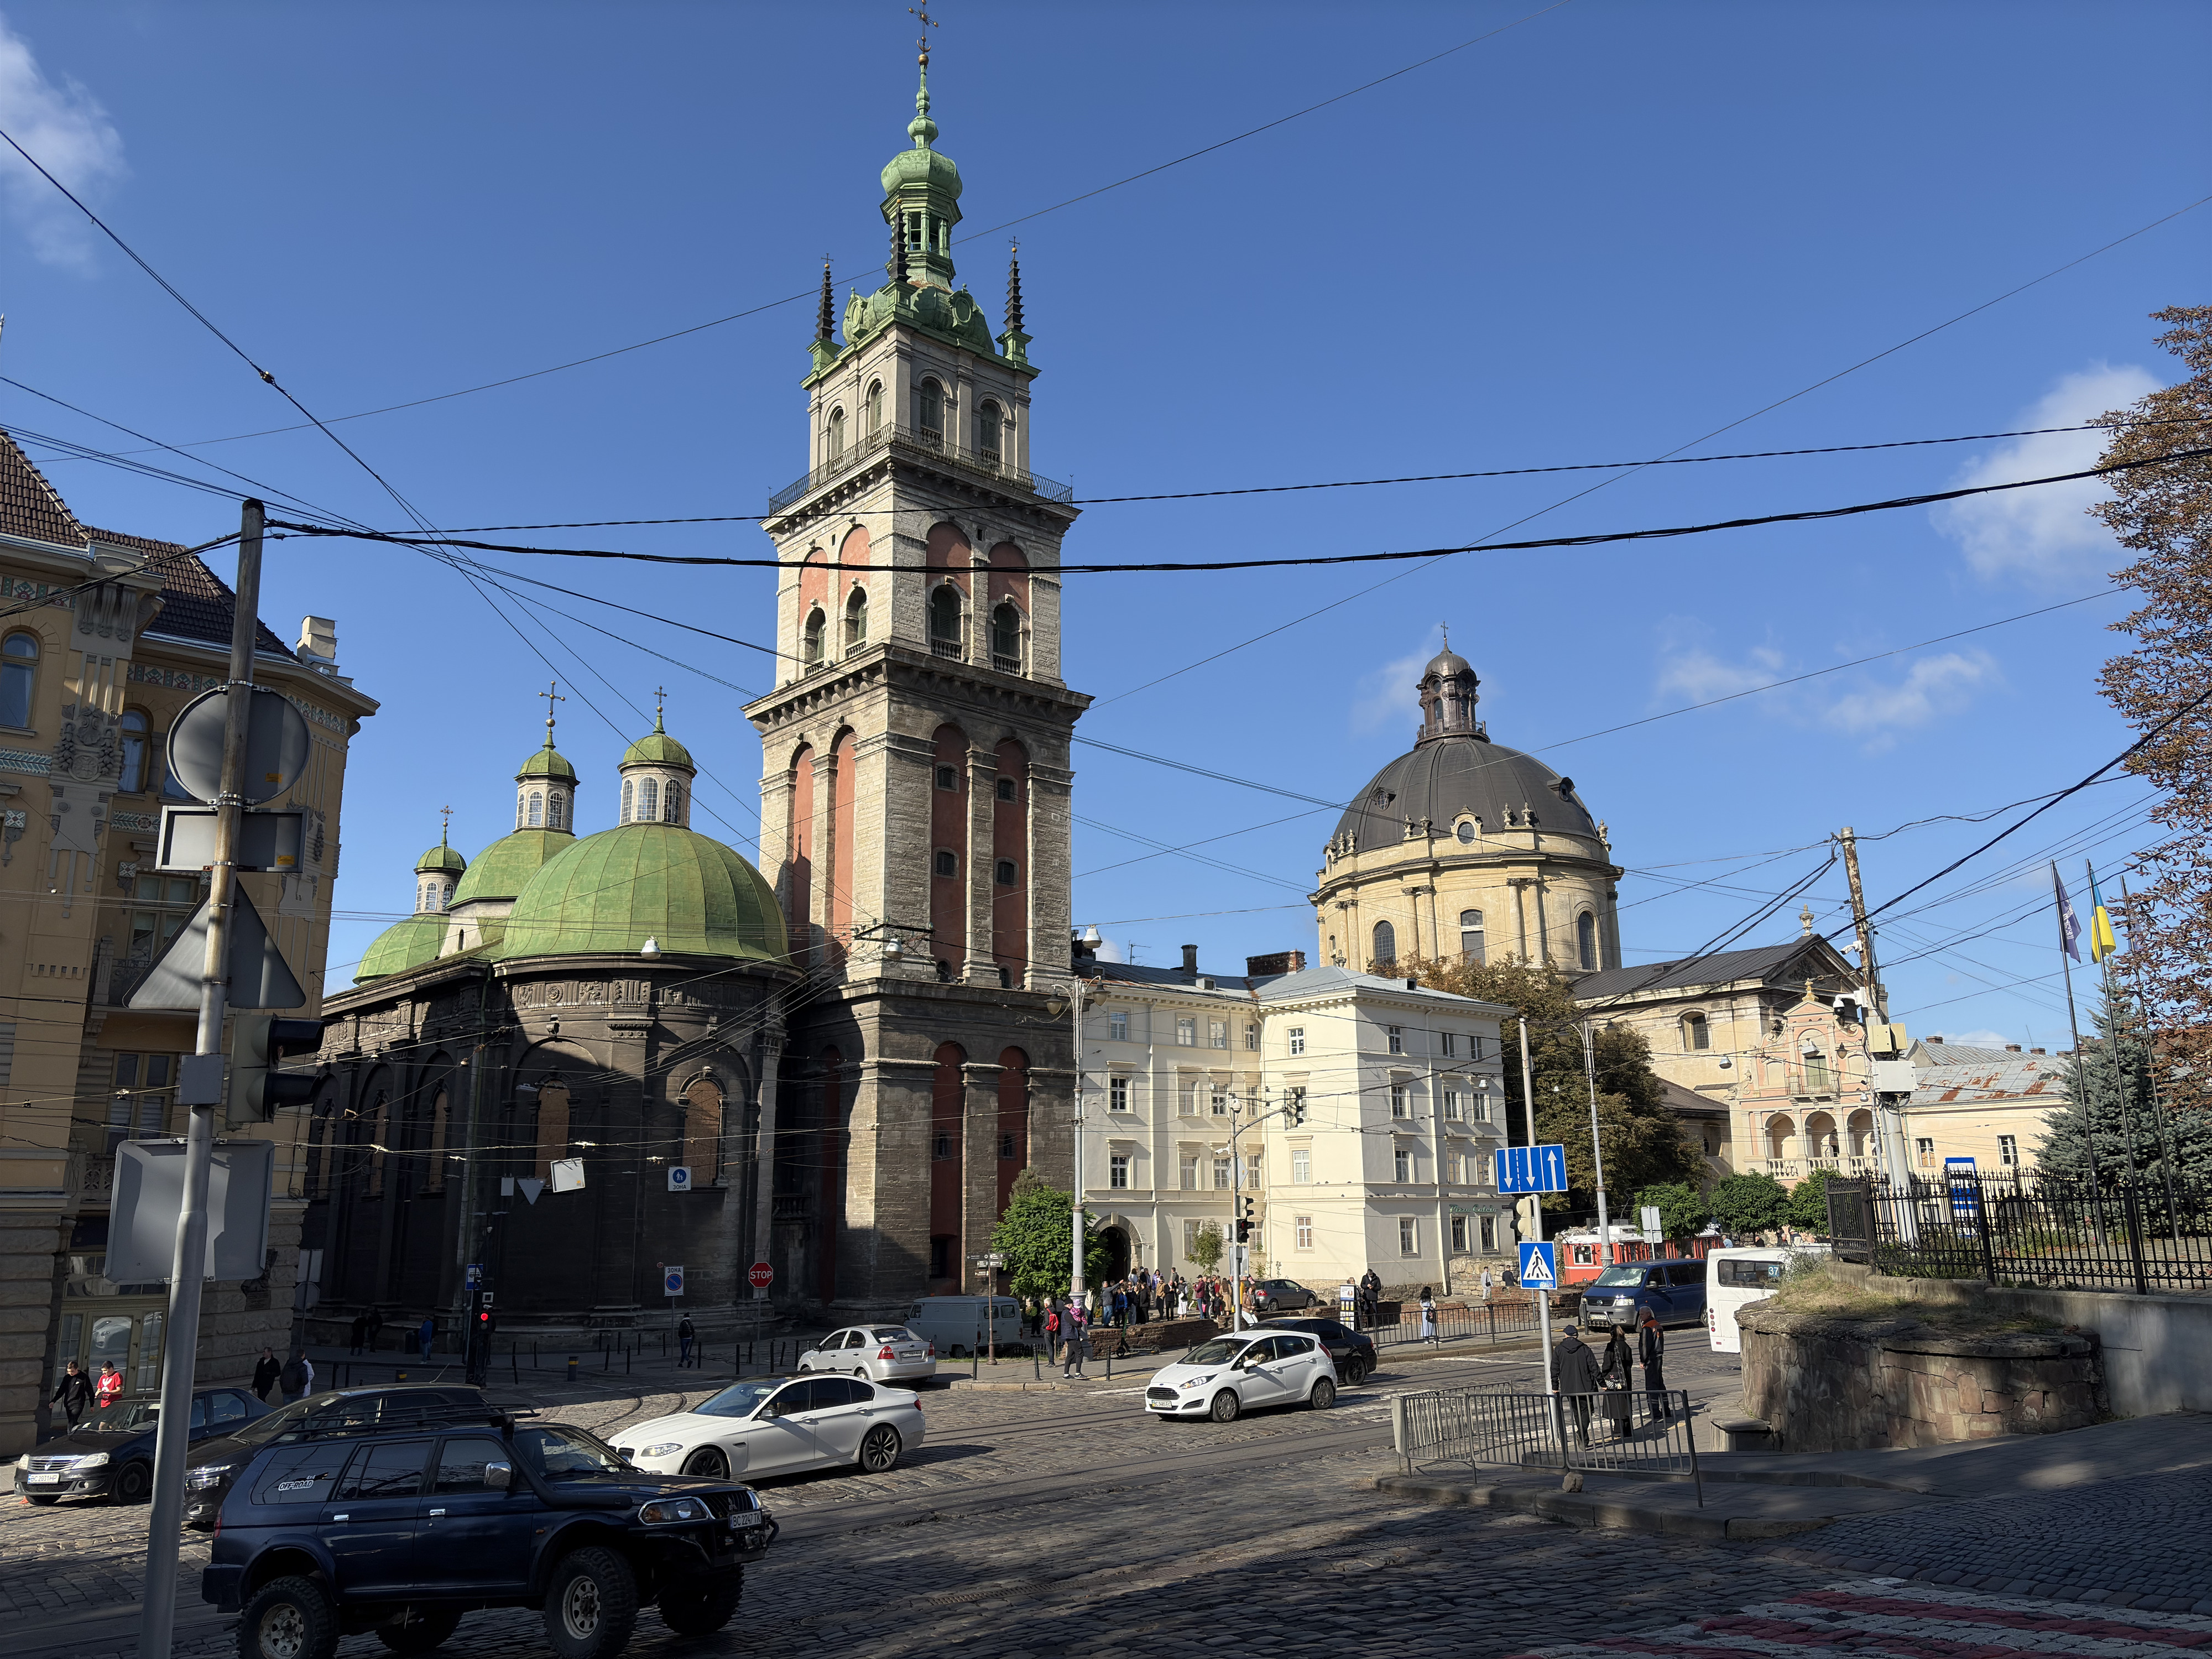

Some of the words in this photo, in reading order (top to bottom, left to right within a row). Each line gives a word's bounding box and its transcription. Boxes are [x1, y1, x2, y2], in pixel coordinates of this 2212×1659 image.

[1449, 1204, 1471, 1213] Pizza
[1473, 1204, 1498, 1213] Calcio
[750, 1271, 772, 1279] STOP
[1768, 1266, 1778, 1275] 37
[279, 1480, 314, 1490] OFF-ROAD
[733, 1516, 741, 1526] BC
[742, 1514, 753, 1525] 2247
[753, 1512, 761, 1523] TK
